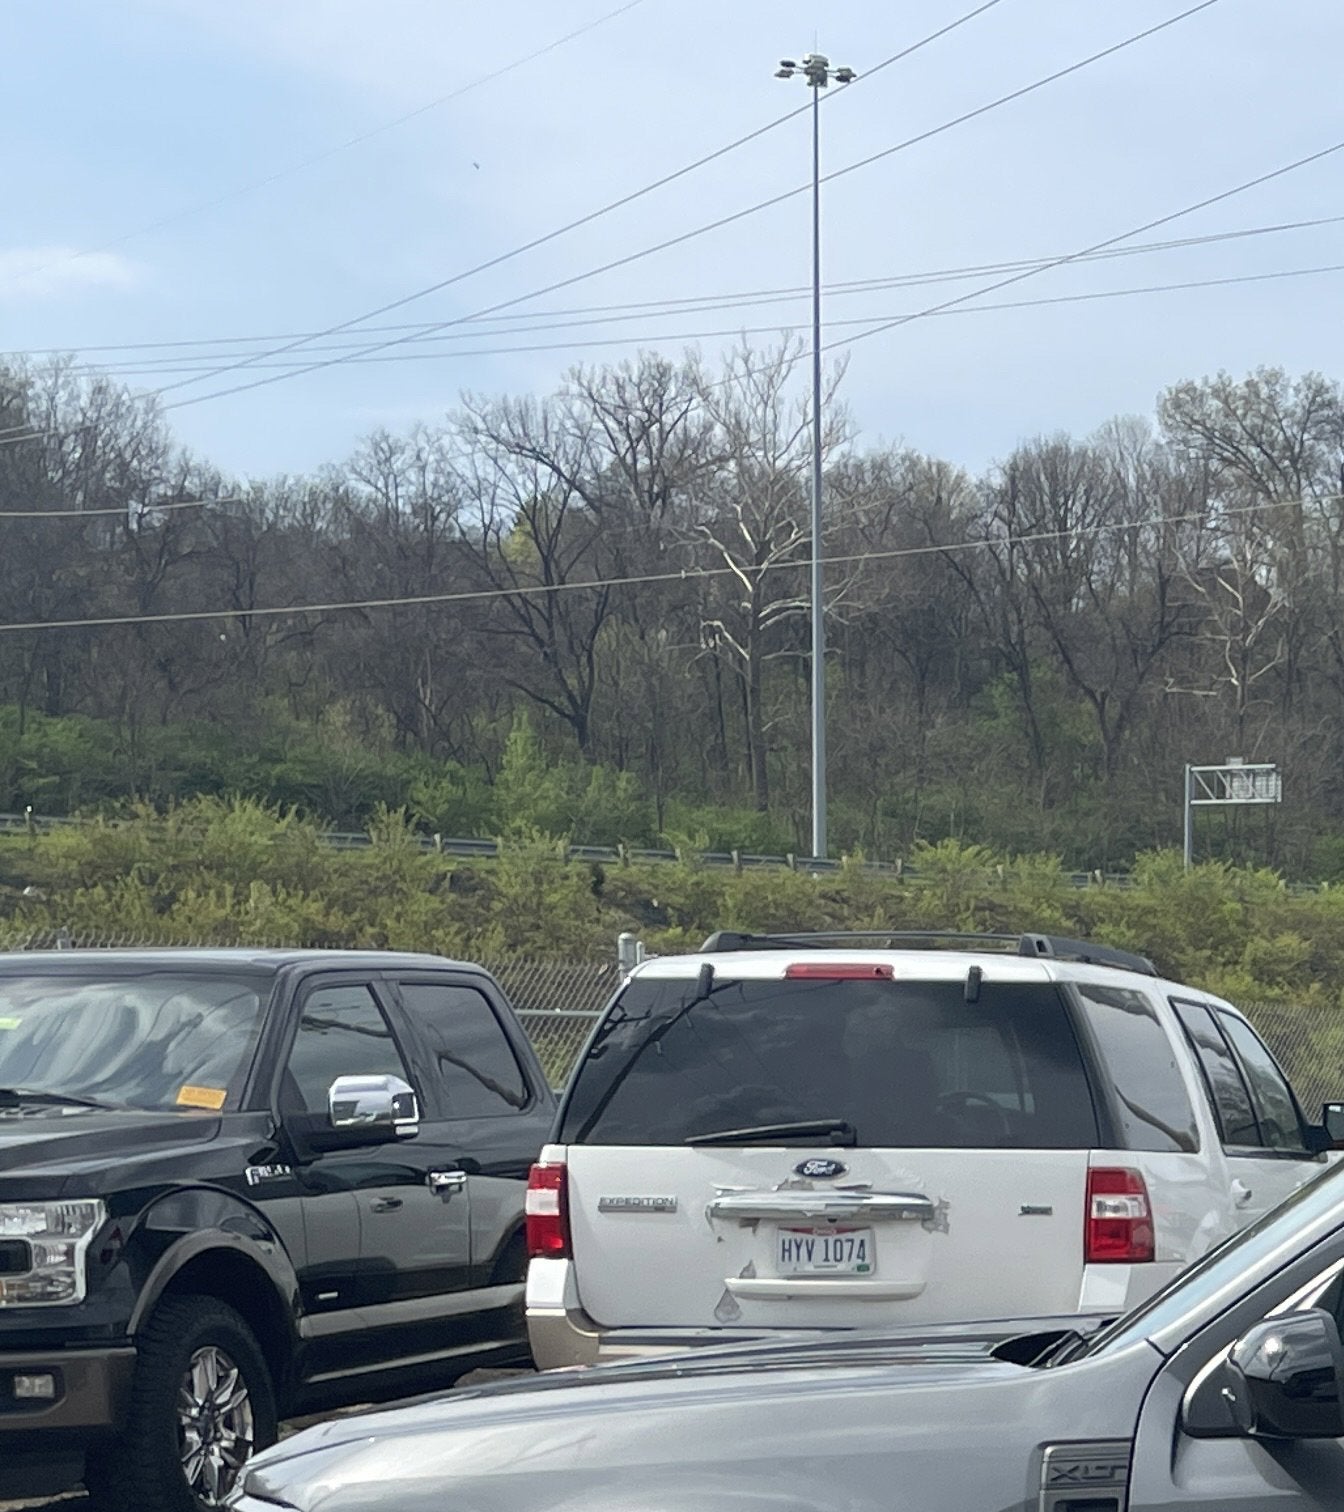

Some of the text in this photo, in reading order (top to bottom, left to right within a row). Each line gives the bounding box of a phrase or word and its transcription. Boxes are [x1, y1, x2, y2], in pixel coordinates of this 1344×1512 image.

[801, 1160, 838, 1175] Ford
[599, 1196, 675, 1207] EXPEDITION
[780, 1238, 867, 1263] HYV 1074
[1050, 1465, 1128, 1482] XLT
